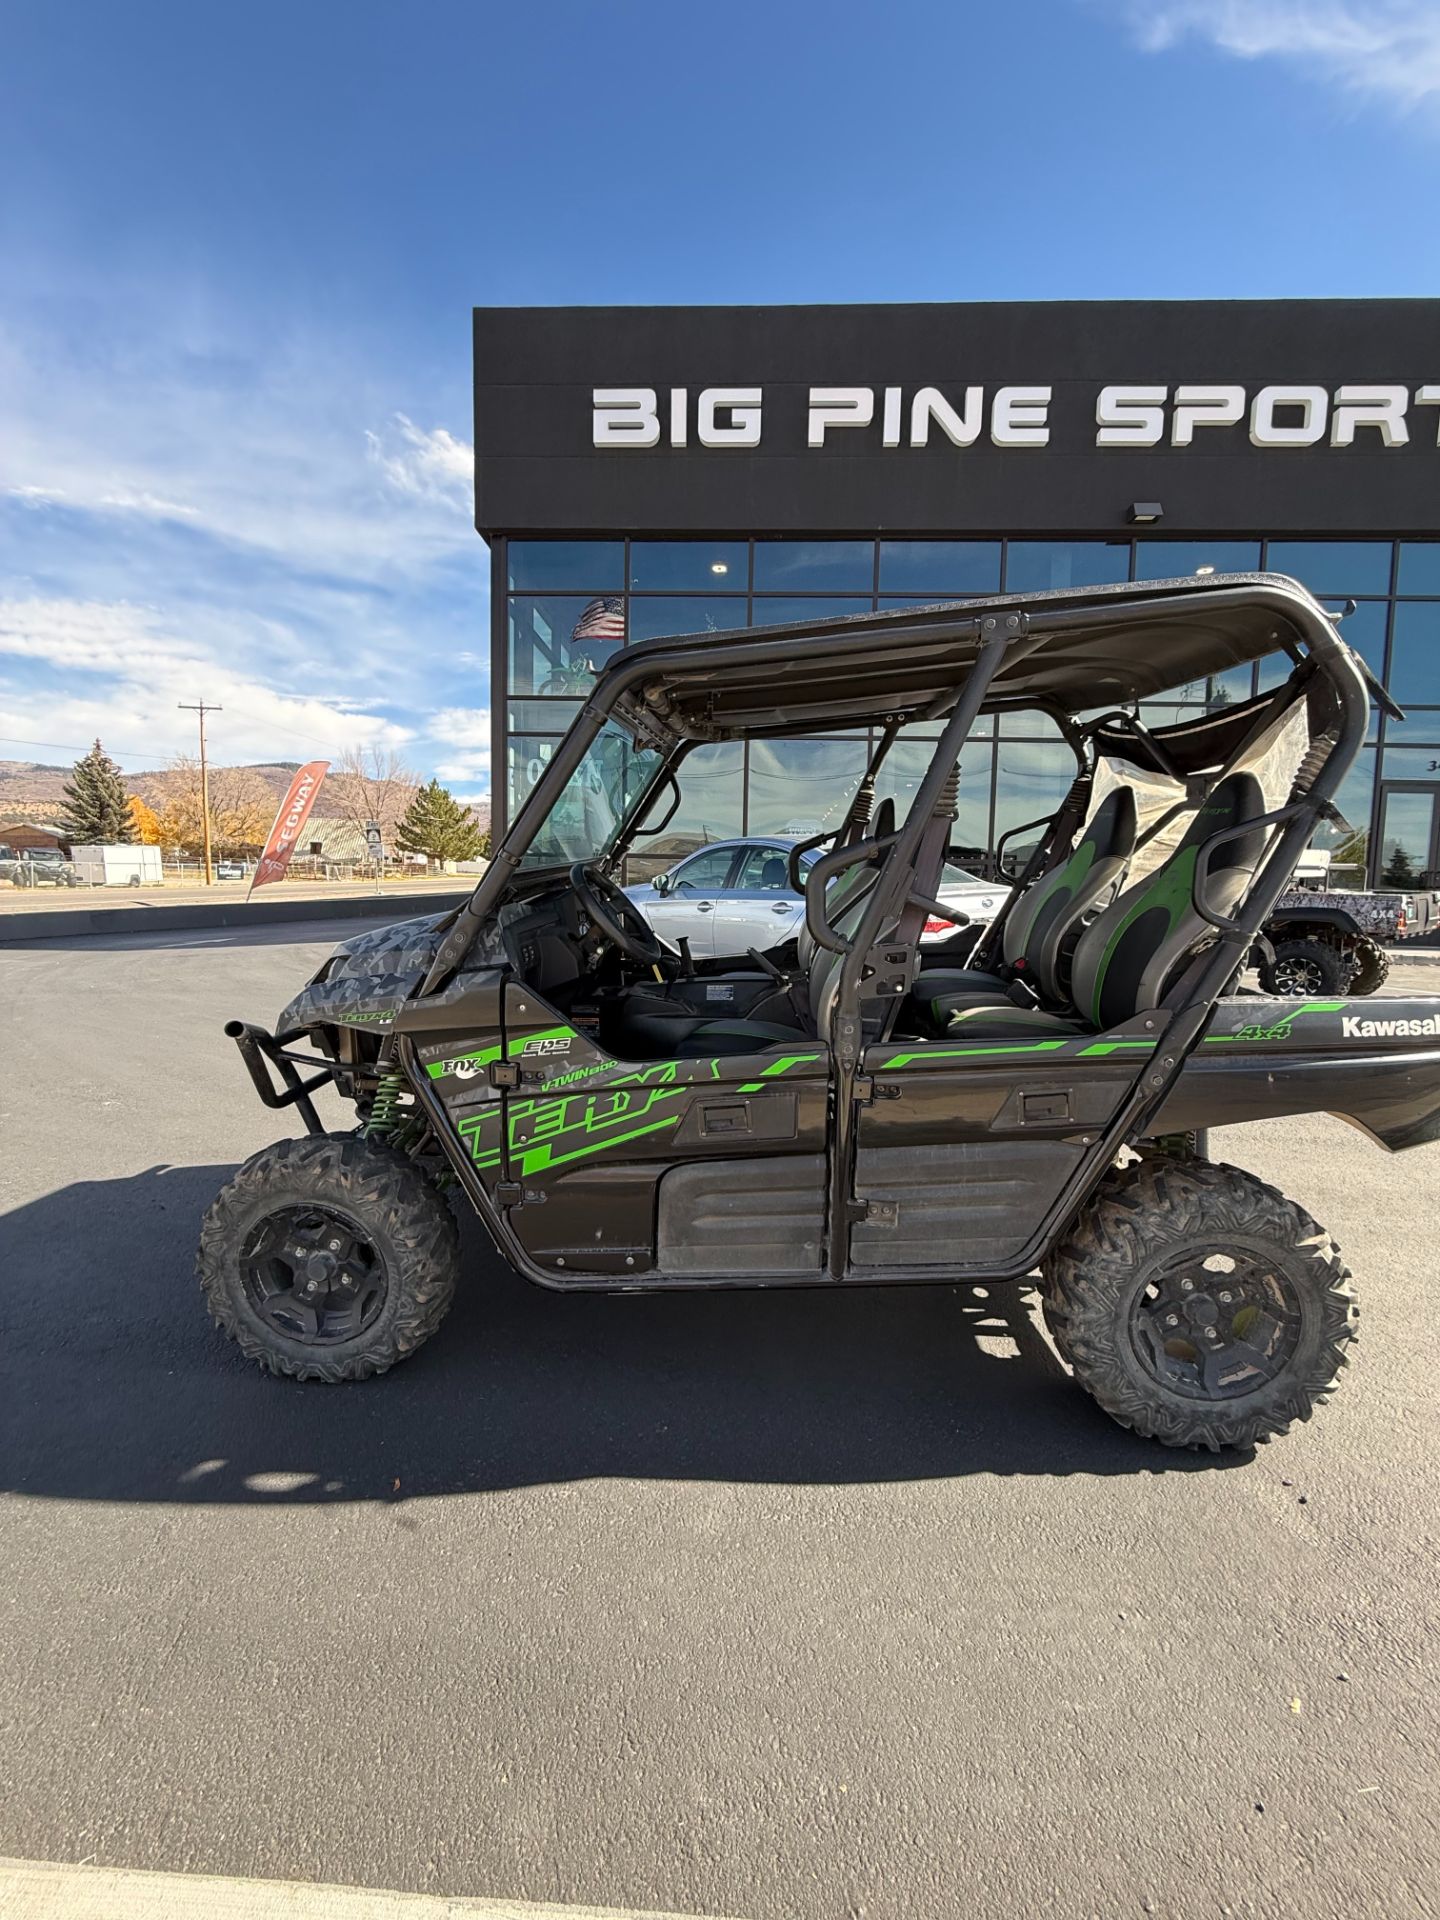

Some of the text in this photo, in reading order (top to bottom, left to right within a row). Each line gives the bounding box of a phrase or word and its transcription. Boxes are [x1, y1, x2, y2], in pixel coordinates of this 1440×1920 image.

[592, 387, 763, 448] BIG
[807, 385, 1053, 448] PINE
[276, 772, 315, 853] SEGWAY
[442, 1057, 485, 1074] FOX
[523, 1038, 572, 1054] EPS
